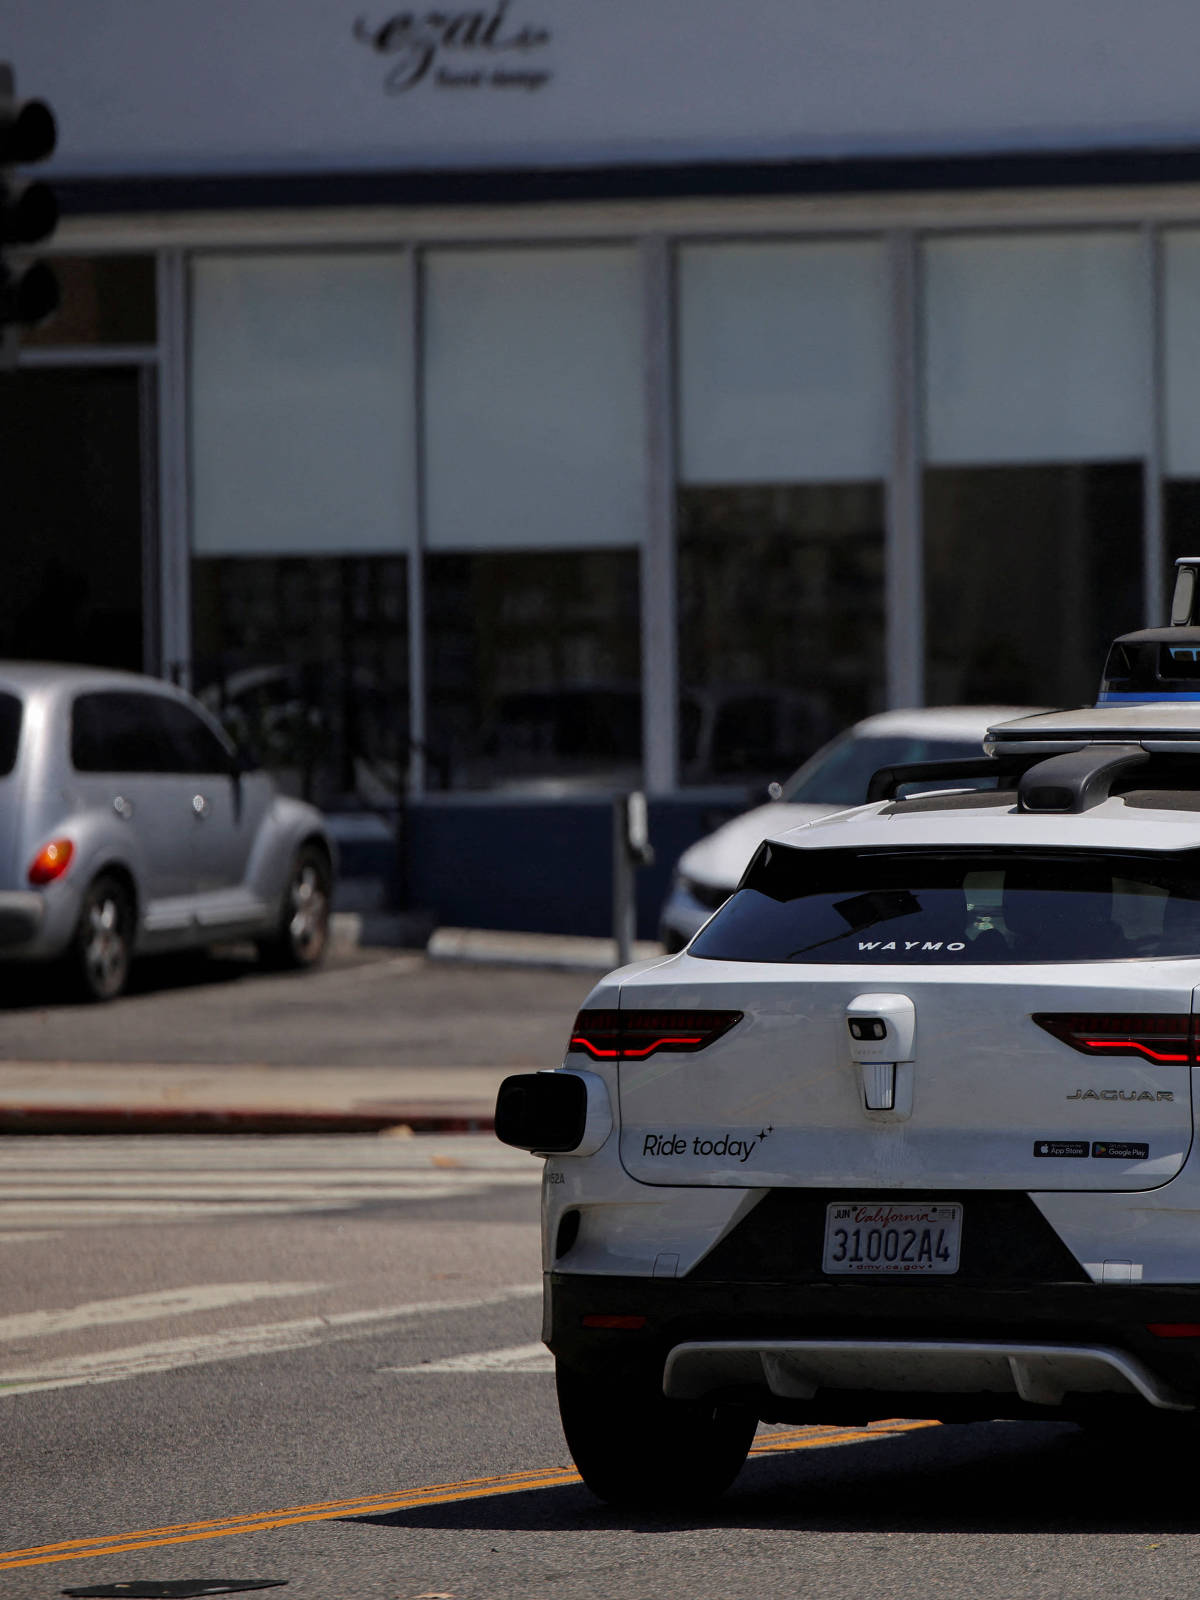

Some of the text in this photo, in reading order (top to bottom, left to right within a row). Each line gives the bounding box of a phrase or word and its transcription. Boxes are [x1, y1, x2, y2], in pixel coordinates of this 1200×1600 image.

[859, 941, 966, 951] WAYMO
[1066, 1089, 1174, 1102] JAGUAR
[642, 1133, 756, 1163] Ride today
[1050, 1147, 1065, 1155] App
[1108, 1148, 1146, 1158] Google Play
[855, 1207, 937, 1229] California
[832, 1229, 950, 1262] 31002A4
